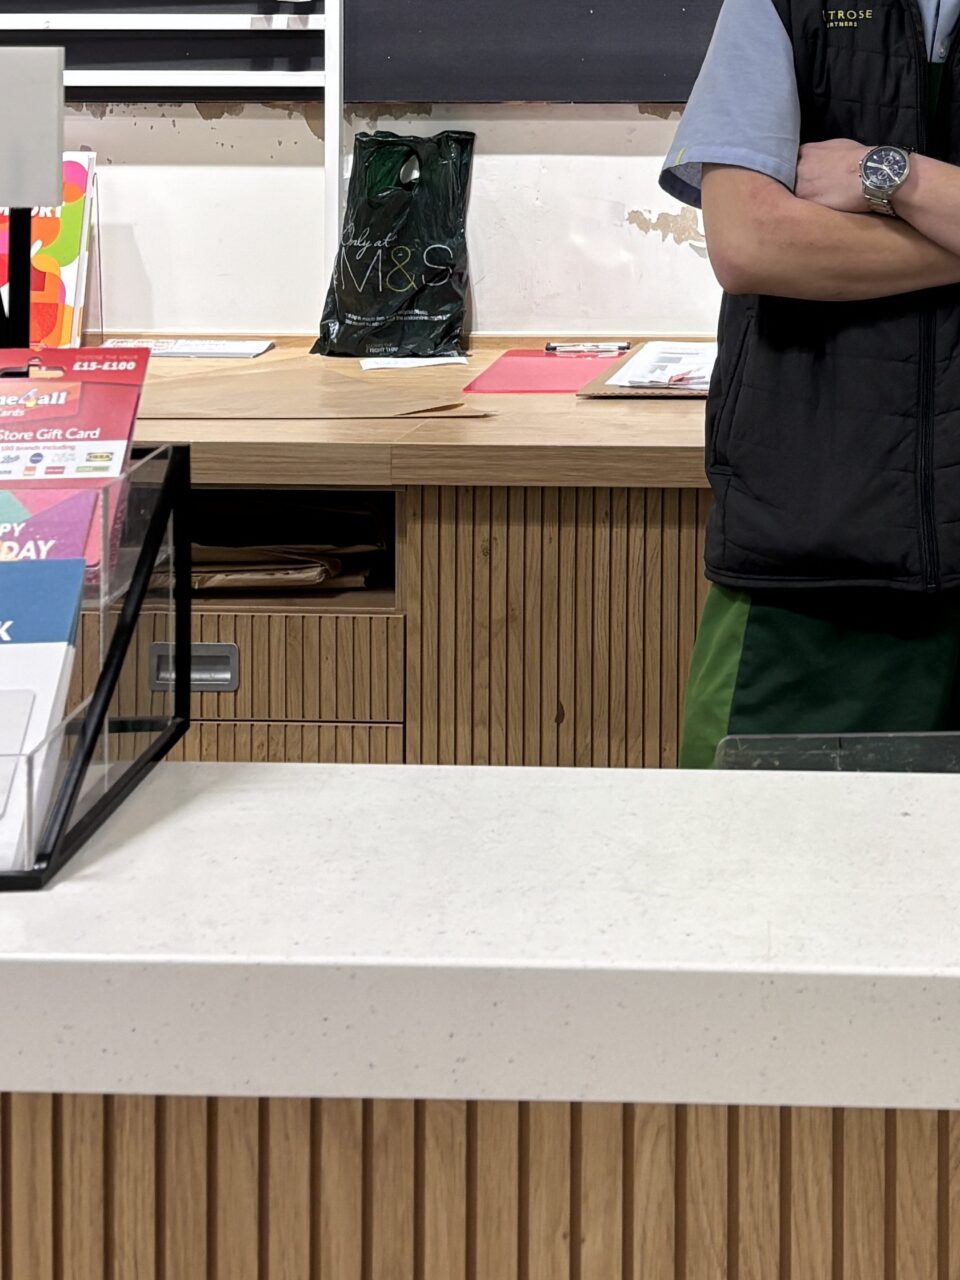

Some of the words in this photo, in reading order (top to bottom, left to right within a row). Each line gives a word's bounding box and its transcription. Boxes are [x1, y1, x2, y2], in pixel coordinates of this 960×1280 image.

[823, 9, 873, 20] TROSE
[374, 232, 397, 247] at
[341, 244, 453, 293] M&S
[36, 428, 63, 439] Gift
[66, 427, 101, 439] Card
